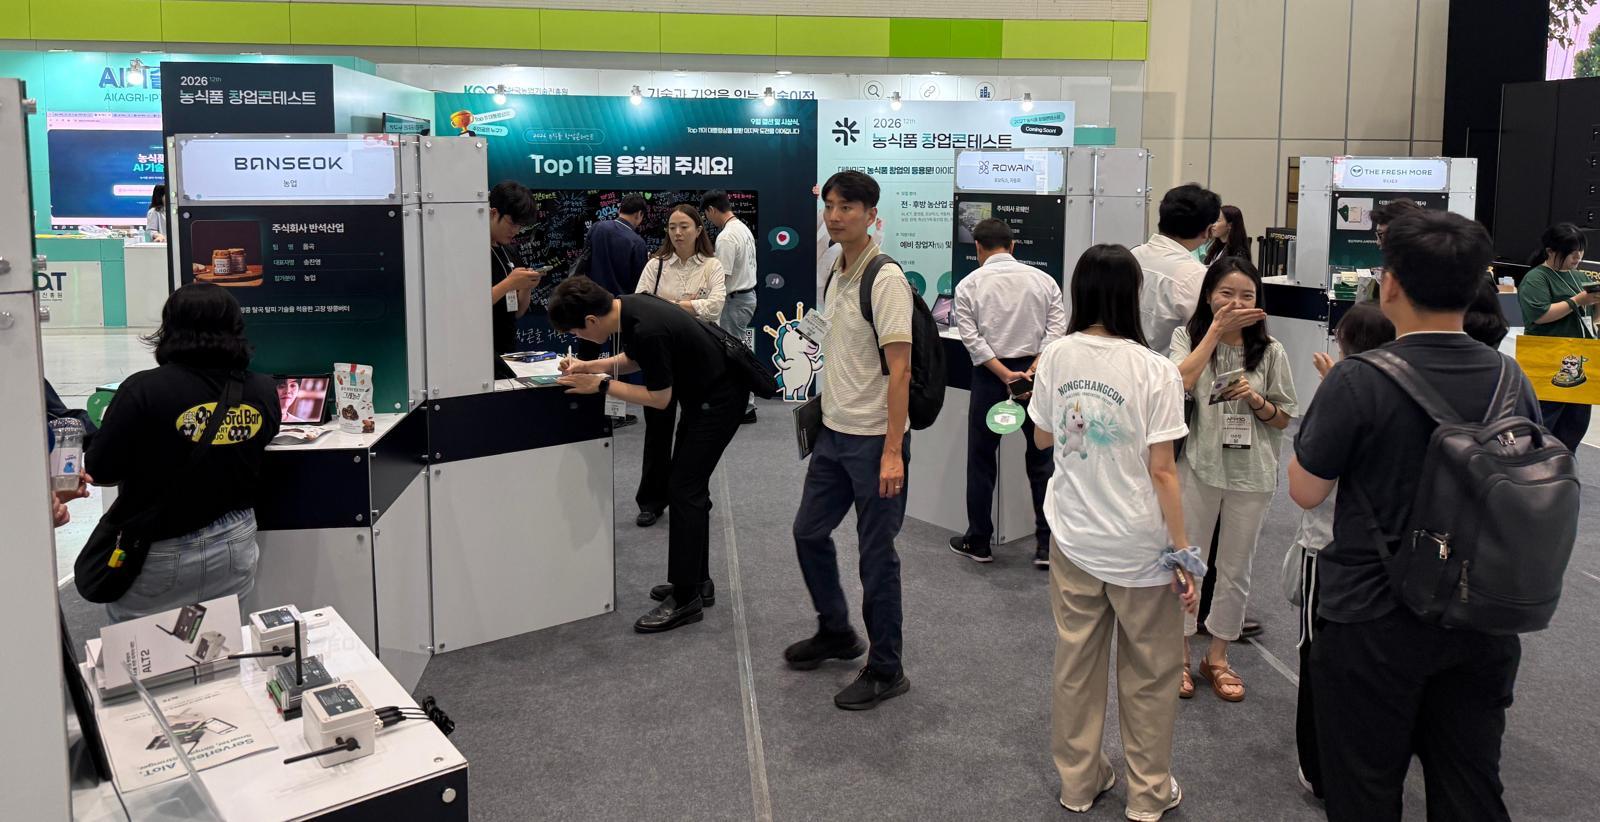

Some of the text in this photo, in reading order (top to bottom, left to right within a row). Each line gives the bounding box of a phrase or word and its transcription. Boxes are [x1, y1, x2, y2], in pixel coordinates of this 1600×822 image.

[180, 76, 208, 86] 2026
[180, 90, 316, 105] 농식품 창업콘테스트
[873, 118, 902, 128] 2026
[872, 133, 1012, 148] 농식품 창업콘테스트
[234, 157, 343, 170] BANSEOK
[529, 154, 733, 176] Top 11을 응원해 주세요!
[992, 164, 1034, 172] ROWAIN
[927, 200, 948, 208] 농산업
[272, 223, 344, 234] 주식회사 반석산업
[900, 240, 914, 248] 예비
[1058, 380, 1126, 406] NONGCHANGCON
[206, 408, 261, 426] Rord Bar
[141, 648, 152, 674] ALT2
[139, 762, 177, 777] AIoT.
